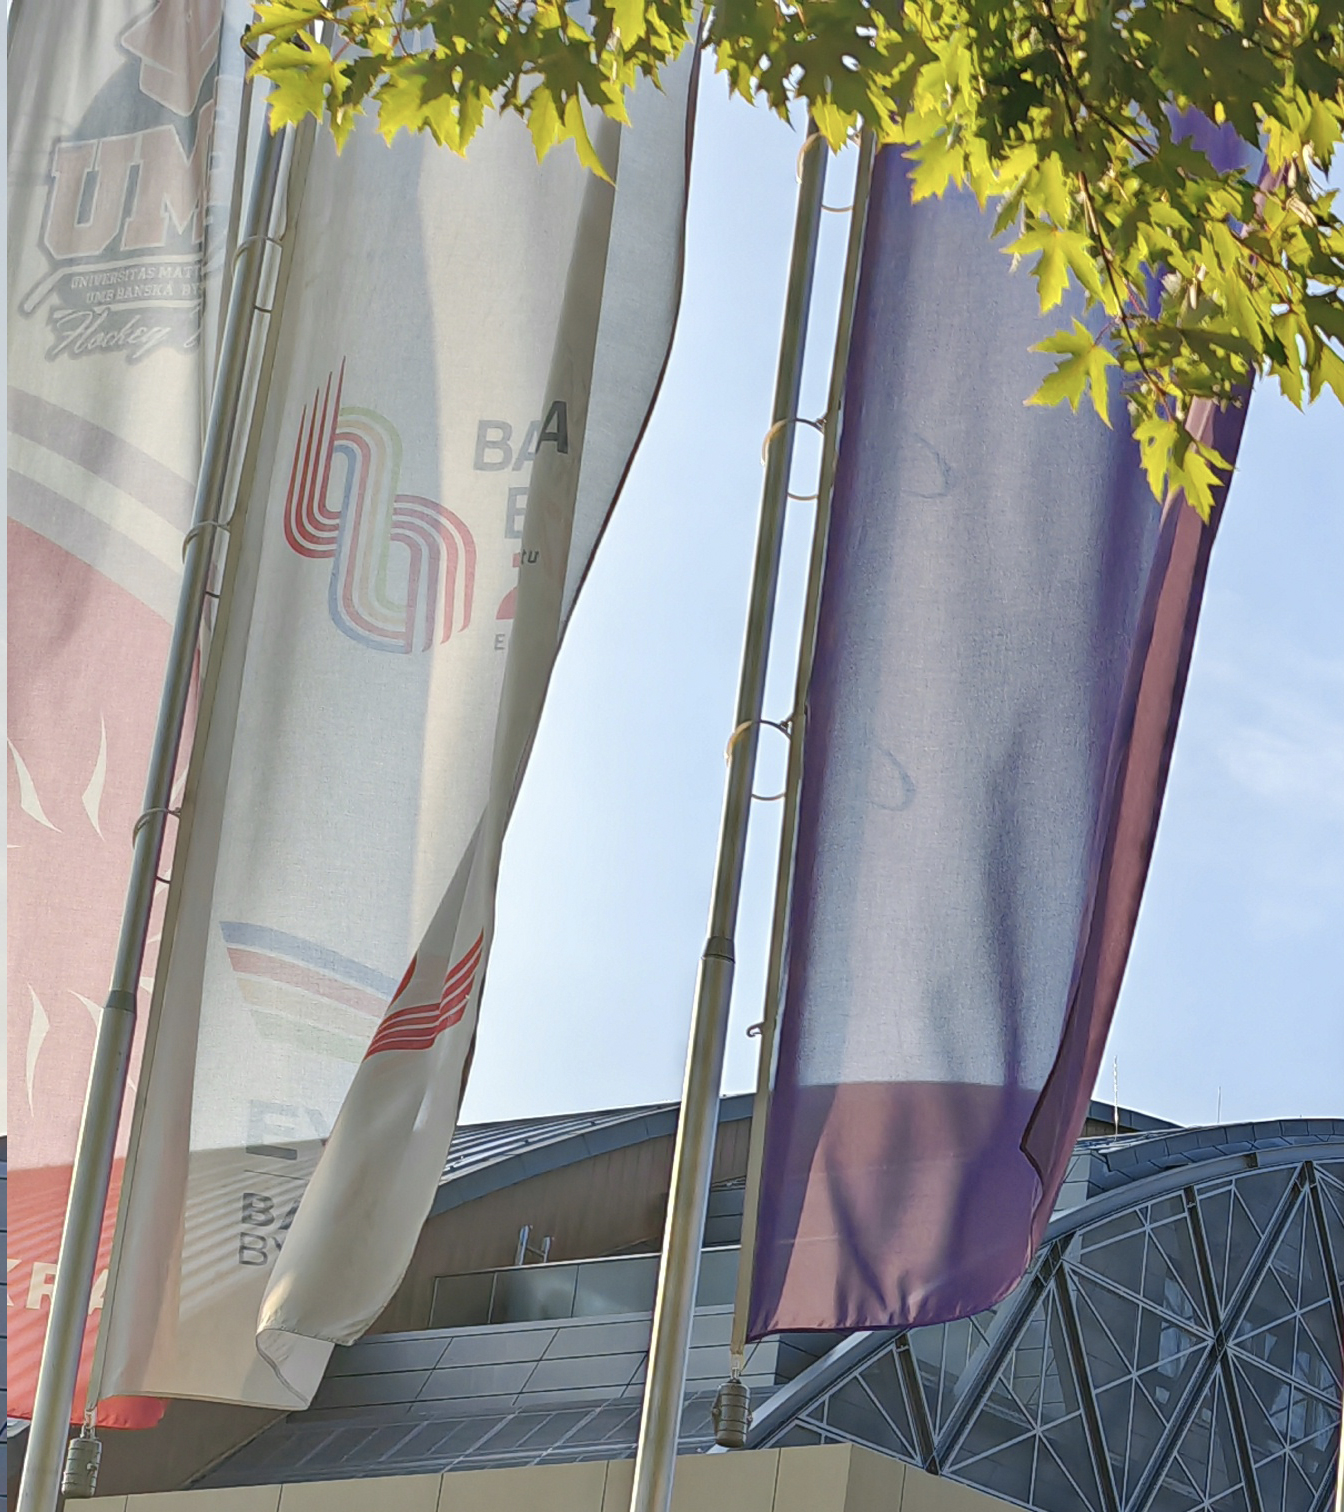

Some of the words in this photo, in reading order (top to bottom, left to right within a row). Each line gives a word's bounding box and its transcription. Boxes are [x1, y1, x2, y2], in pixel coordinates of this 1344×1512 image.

[71, 267, 155, 289] UNIVERSITAS
[117, 281, 174, 300] BANSKÁ
[50, 307, 171, 360] Hockey
